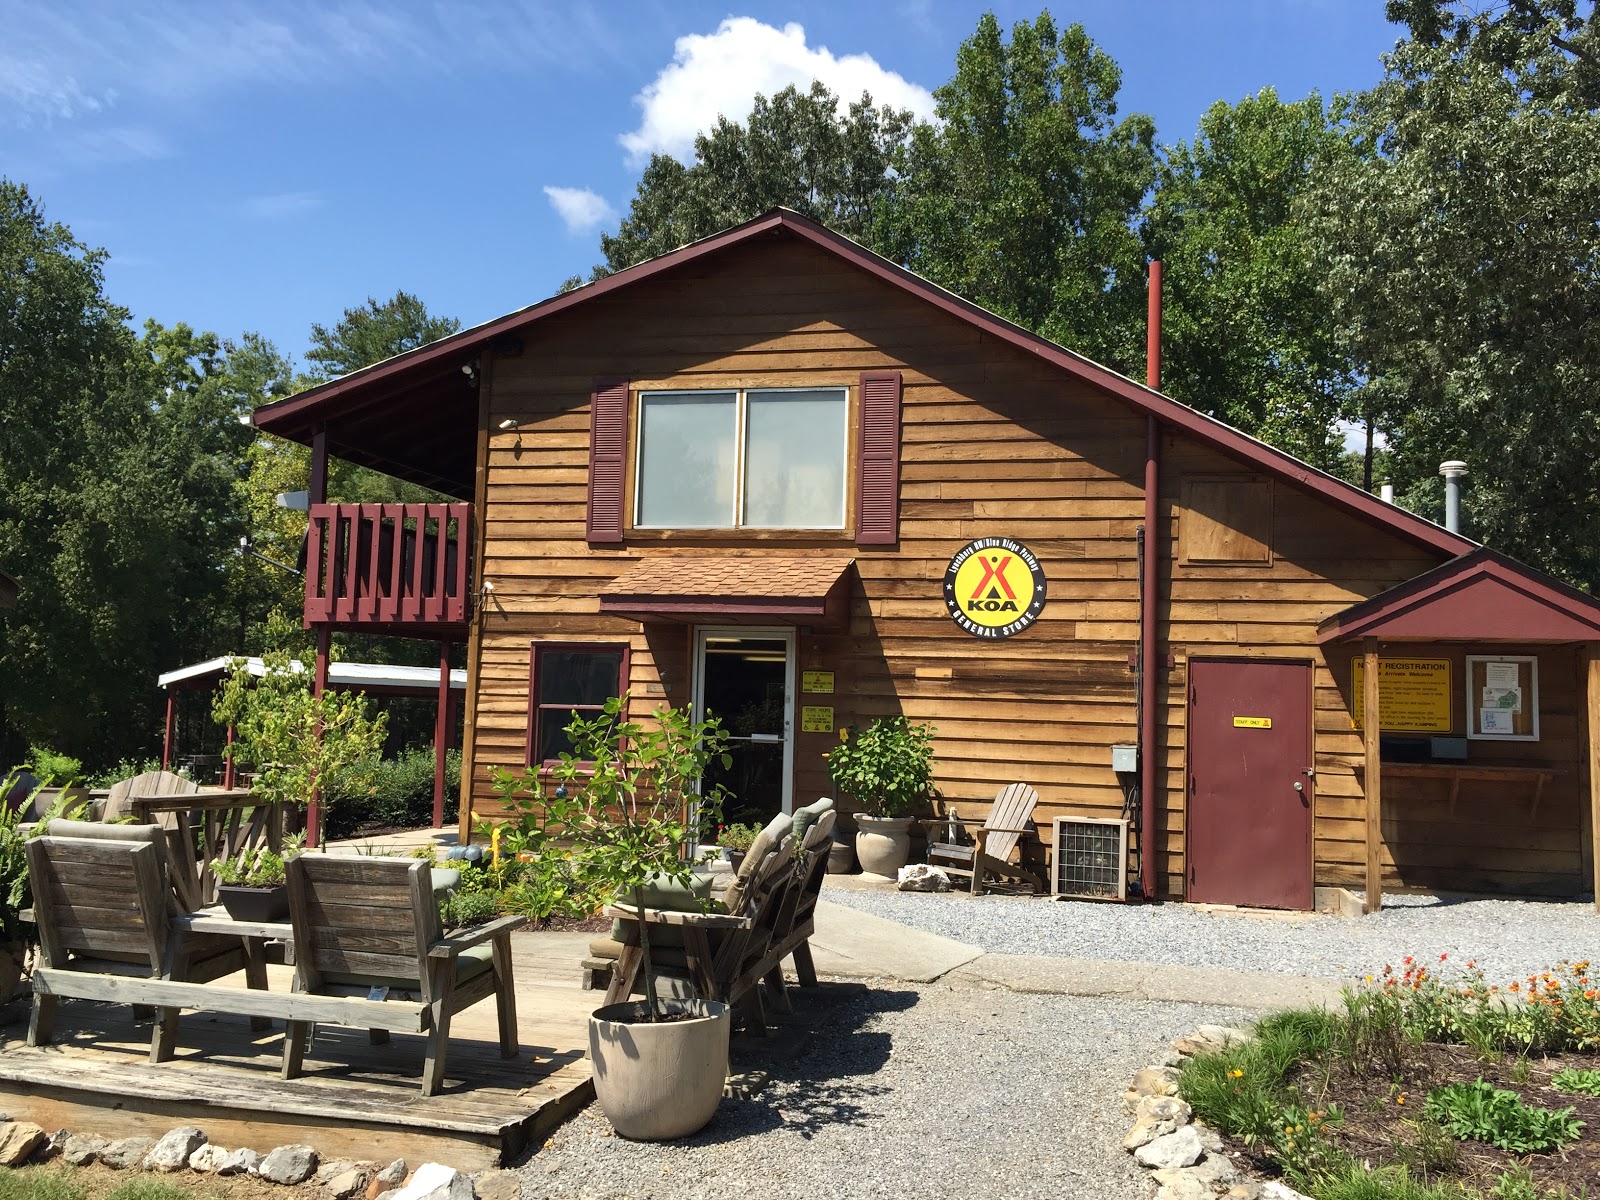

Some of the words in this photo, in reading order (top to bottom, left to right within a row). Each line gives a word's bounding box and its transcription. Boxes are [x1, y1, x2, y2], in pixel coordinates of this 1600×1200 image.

[949, 547, 975, 573] Lynchburg
[1002, 539, 1020, 552] Ridge
[1019, 547, 1039, 572] Parkway
[967, 600, 1019, 612] KOA
[952, 610, 997, 637] GENERAL
[1002, 611, 1035, 636] STORE
